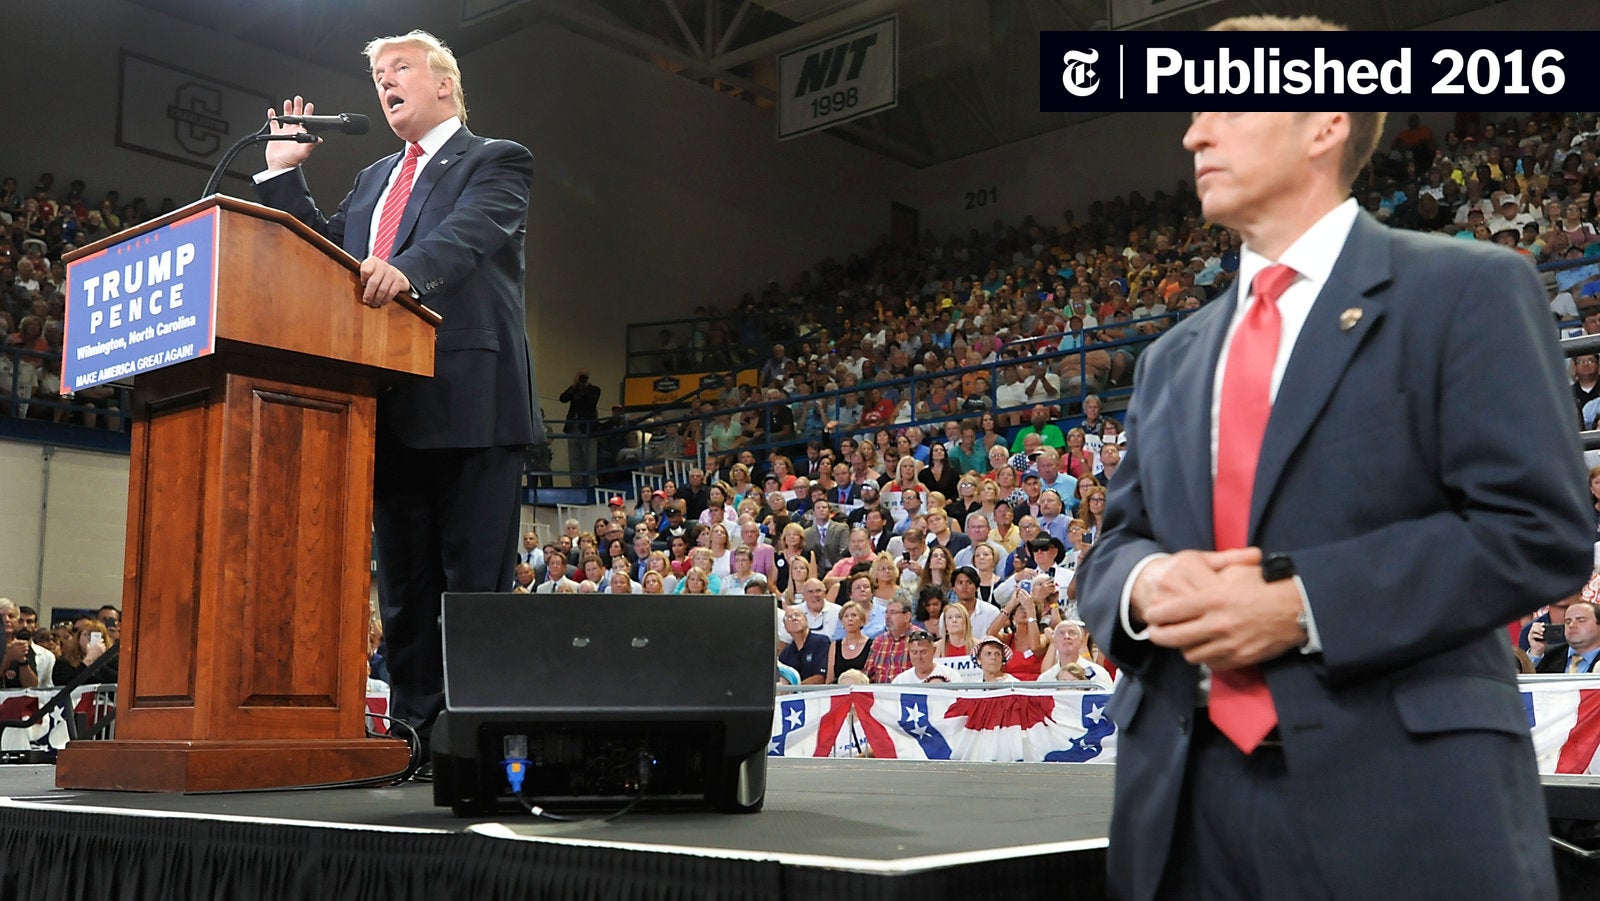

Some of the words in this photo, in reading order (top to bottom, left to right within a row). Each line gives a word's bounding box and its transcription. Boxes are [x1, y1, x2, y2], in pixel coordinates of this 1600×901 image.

[794, 32, 879, 98] NIT
[810, 87, 858, 118] 1998
[964, 185, 998, 210] 201
[83, 242, 196, 307] TRUMP
[90, 283, 184, 335] PENCE
[76, 337, 127, 360] Wilmington,
[128, 325, 155, 345] North
[156, 315, 197, 336] Carolina
[75, 371, 98, 387] MAKE
[97, 361, 136, 382] AMERICA
[136, 351, 165, 370] GREAT
[163, 343, 194, 362] AGAIN!
